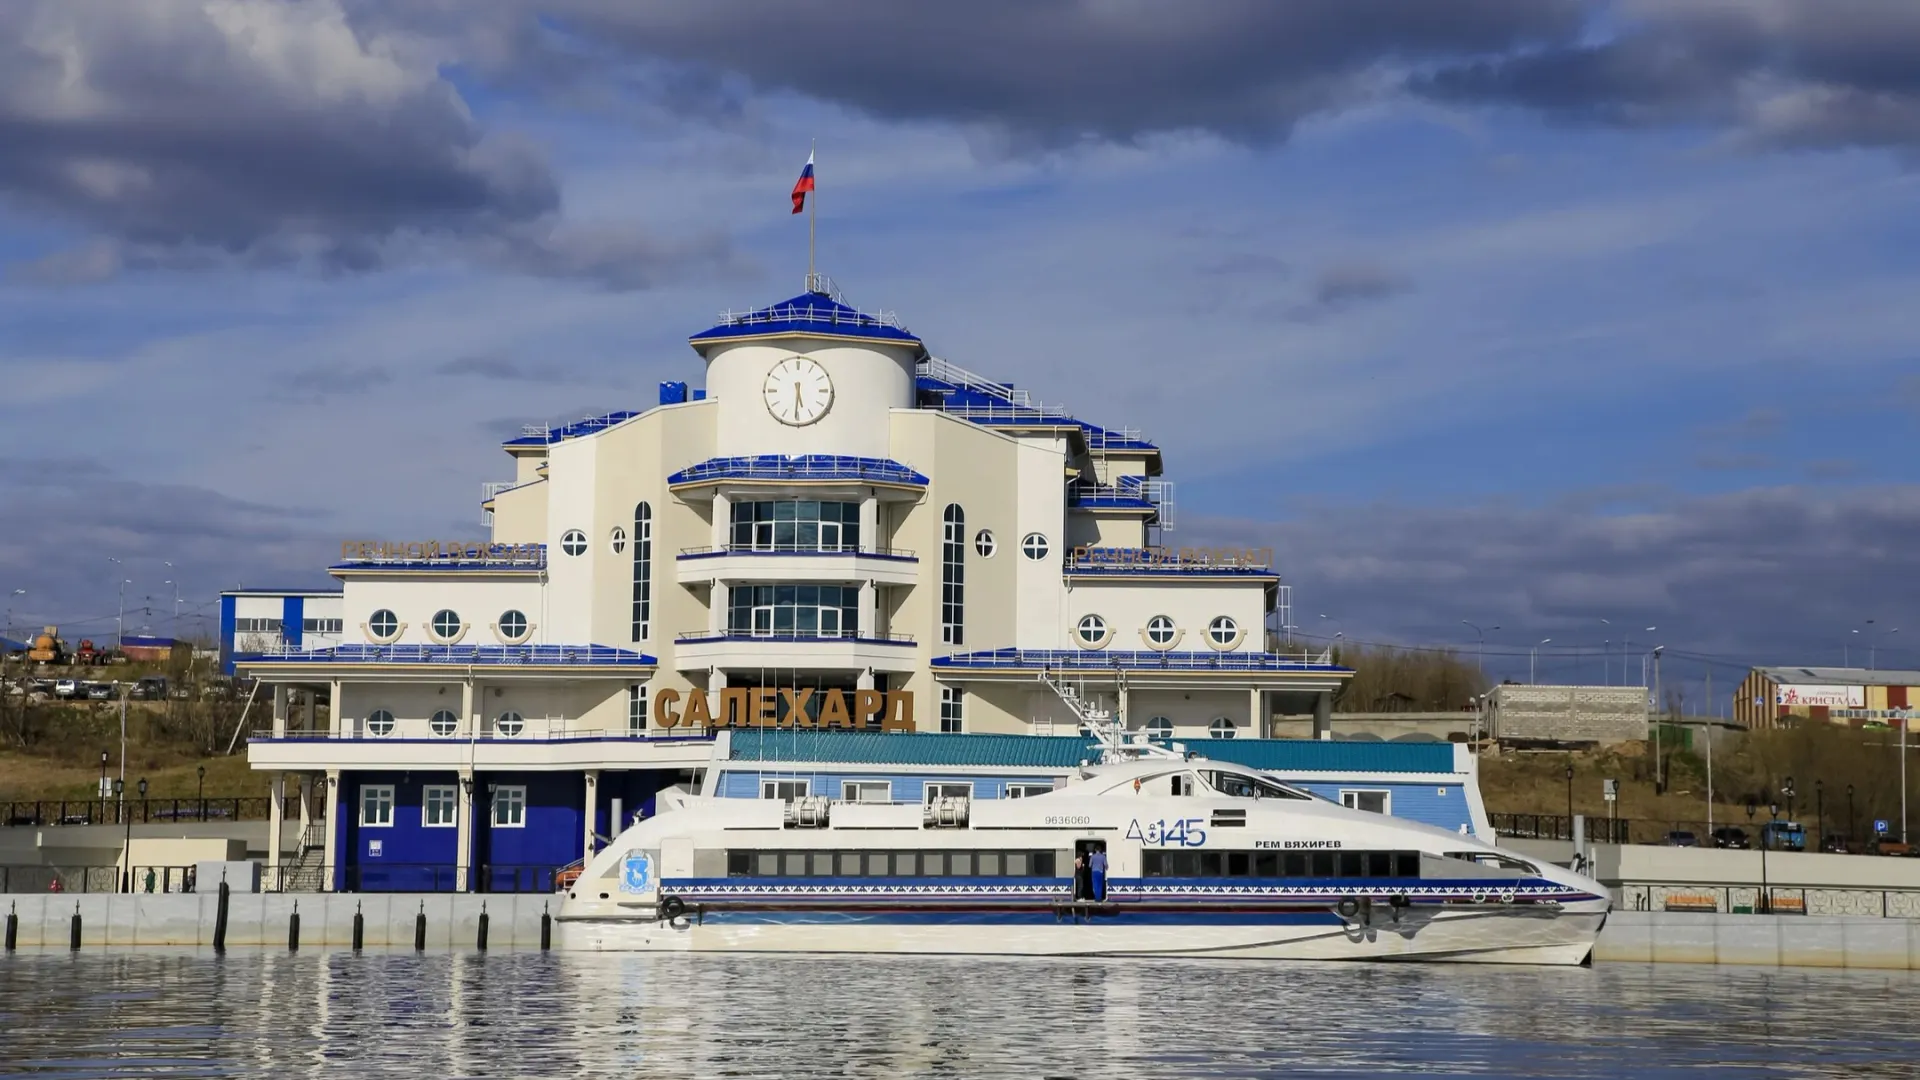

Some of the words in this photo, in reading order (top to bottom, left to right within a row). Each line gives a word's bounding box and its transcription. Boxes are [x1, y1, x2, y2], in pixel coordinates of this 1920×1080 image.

[341, 540, 440, 559] РЕЧНОЙ
[654, 687, 916, 732] САЛЕХАРД
[1045, 816, 1090, 824] 9636060
[1255, 840, 1280, 848] РЕМ
[1284, 840, 1341, 848] ВЯХИРЕВ
